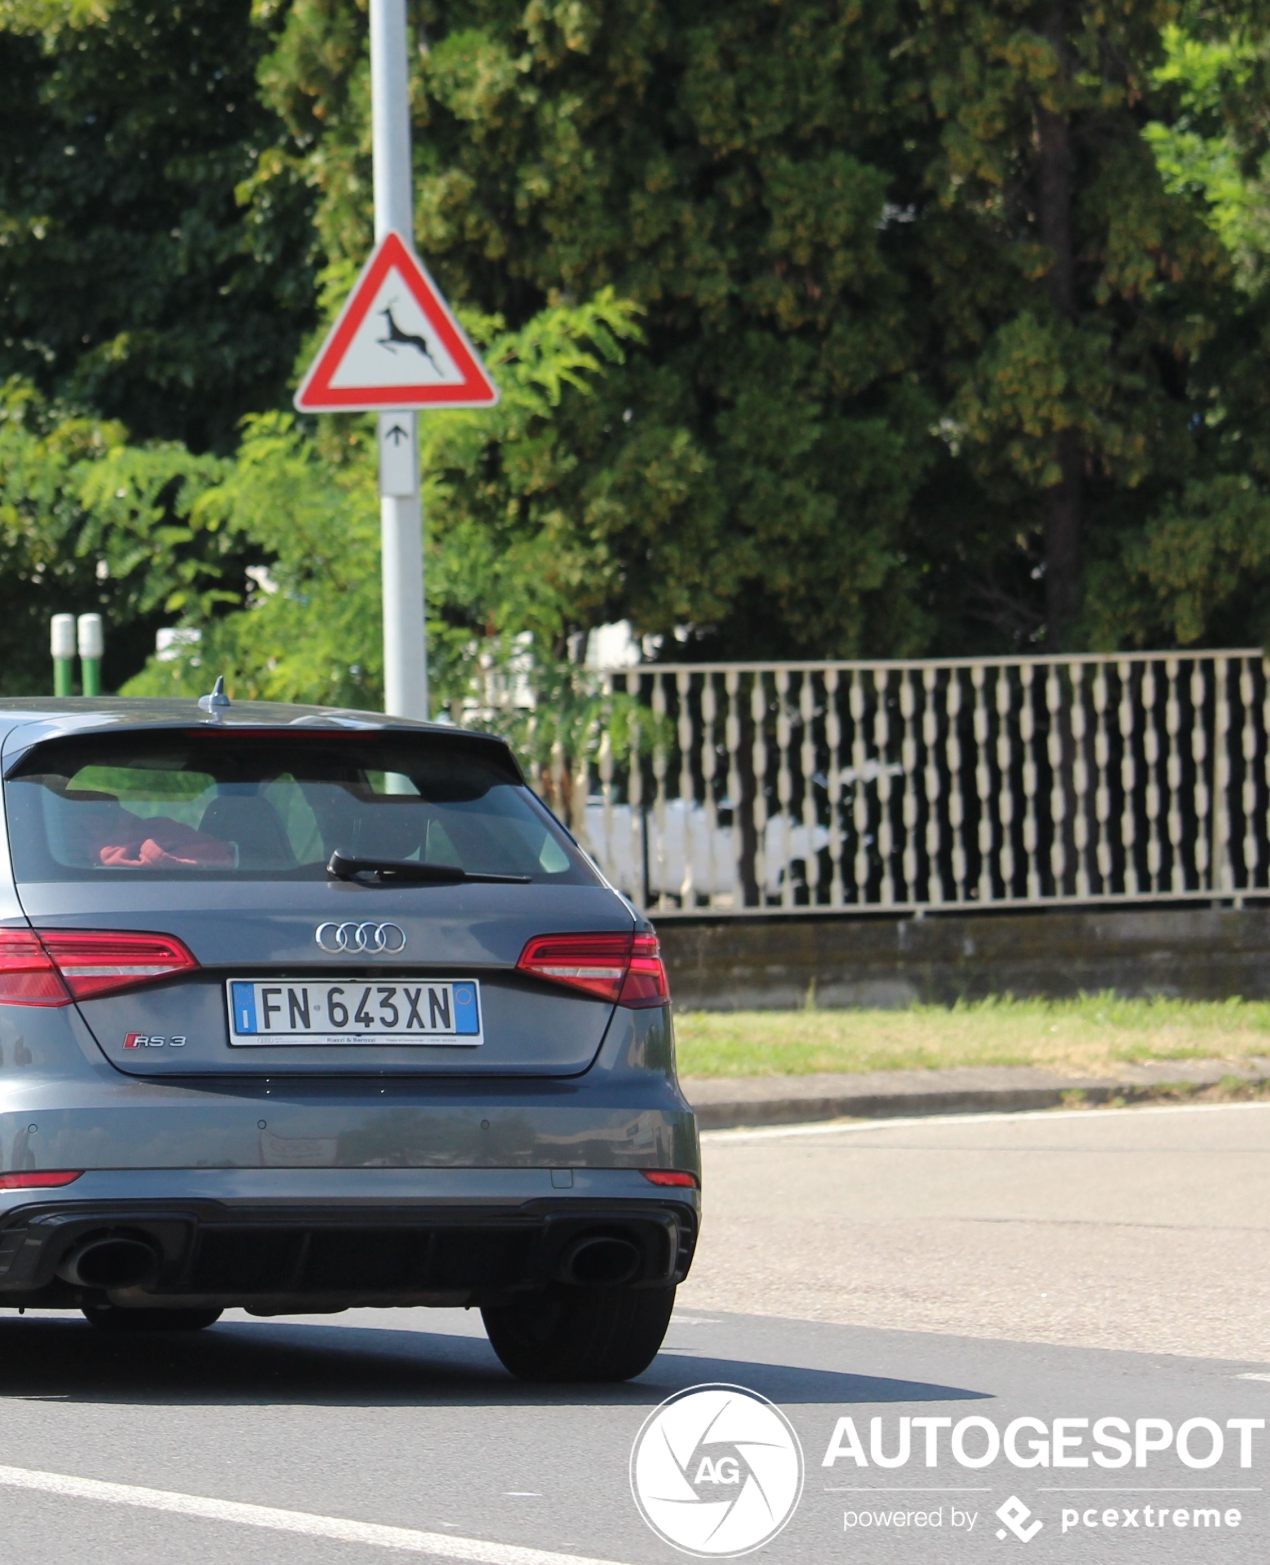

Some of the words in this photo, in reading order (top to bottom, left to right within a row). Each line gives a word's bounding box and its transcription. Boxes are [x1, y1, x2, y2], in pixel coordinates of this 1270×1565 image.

[261, 987, 311, 1029] FN
[327, 987, 452, 1029] 643XN
[132, 1035, 165, 1047] RS
[169, 1035, 187, 1047] 3
